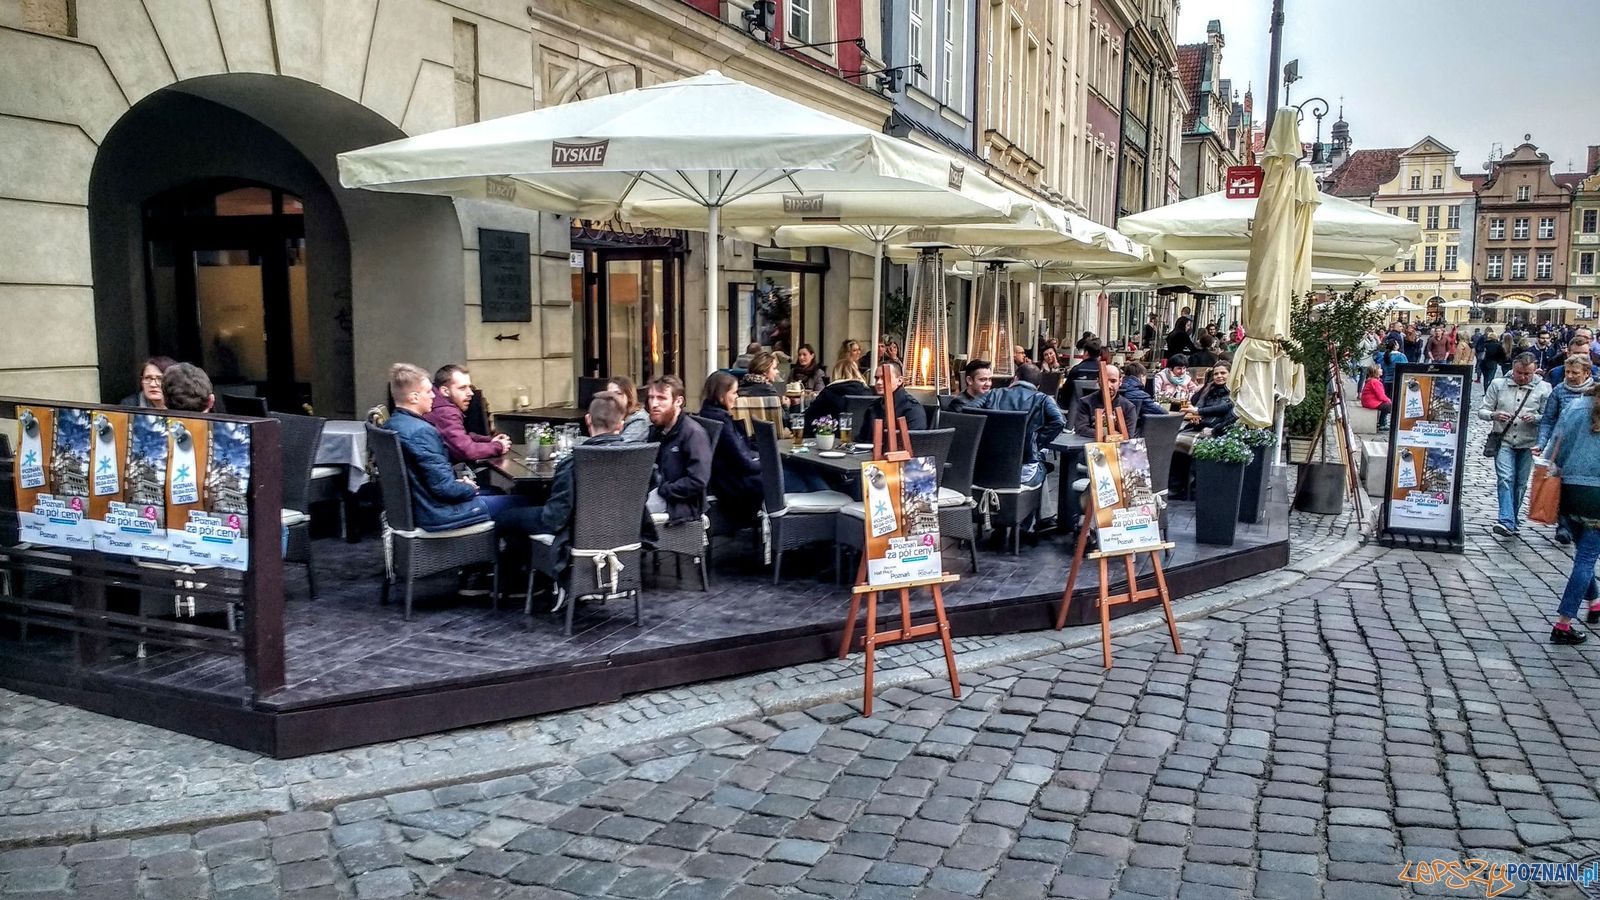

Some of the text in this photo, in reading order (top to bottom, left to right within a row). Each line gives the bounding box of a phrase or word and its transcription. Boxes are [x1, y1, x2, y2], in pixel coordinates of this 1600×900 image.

[554, 145, 604, 162] TYSKIE
[42, 500, 64, 508] Poznań
[46, 508, 59, 518] pół
[61, 511, 82, 521] ceny
[113, 508, 136, 517] Poznań
[107, 516, 156, 531] za pół ceny
[194, 516, 219, 526] Poznań
[1113, 517, 1151, 528] za pół ceny
[199, 526, 214, 536] pół
[217, 529, 240, 540] ceny
[109, 540, 132, 548] Poznań
[893, 542, 917, 550] Poznań
[189, 550, 212, 559] Poznań
[899, 550, 912, 559] pół
[914, 547, 932, 556] ceny
[890, 572, 910, 580] Poznań
